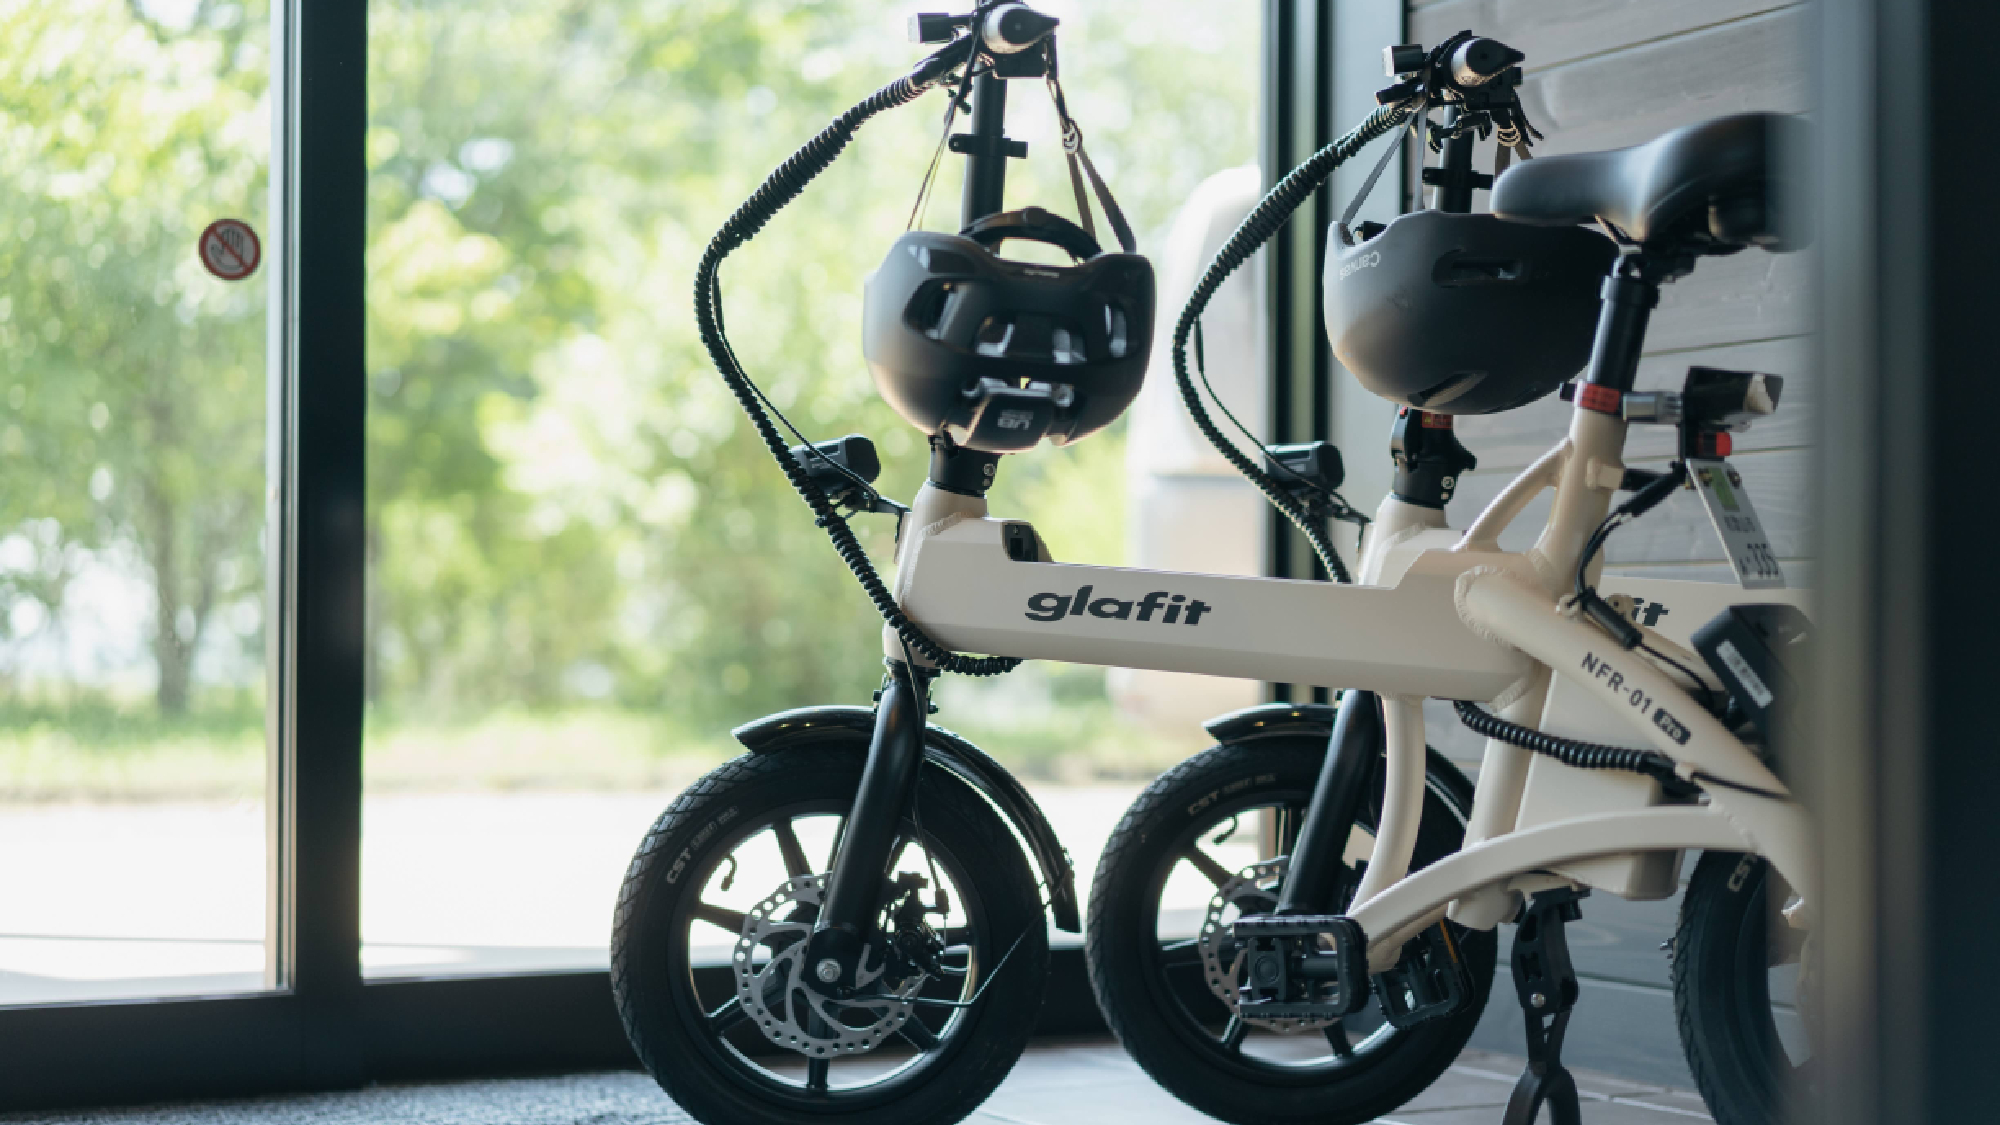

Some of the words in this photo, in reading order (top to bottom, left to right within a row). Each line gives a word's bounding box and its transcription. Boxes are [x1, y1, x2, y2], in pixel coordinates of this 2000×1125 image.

[1025, 585, 1211, 626] glafit
[1580, 651, 1653, 715] NFR-01
[1658, 712, 1682, 741] Pro
[667, 847, 691, 885] CST
